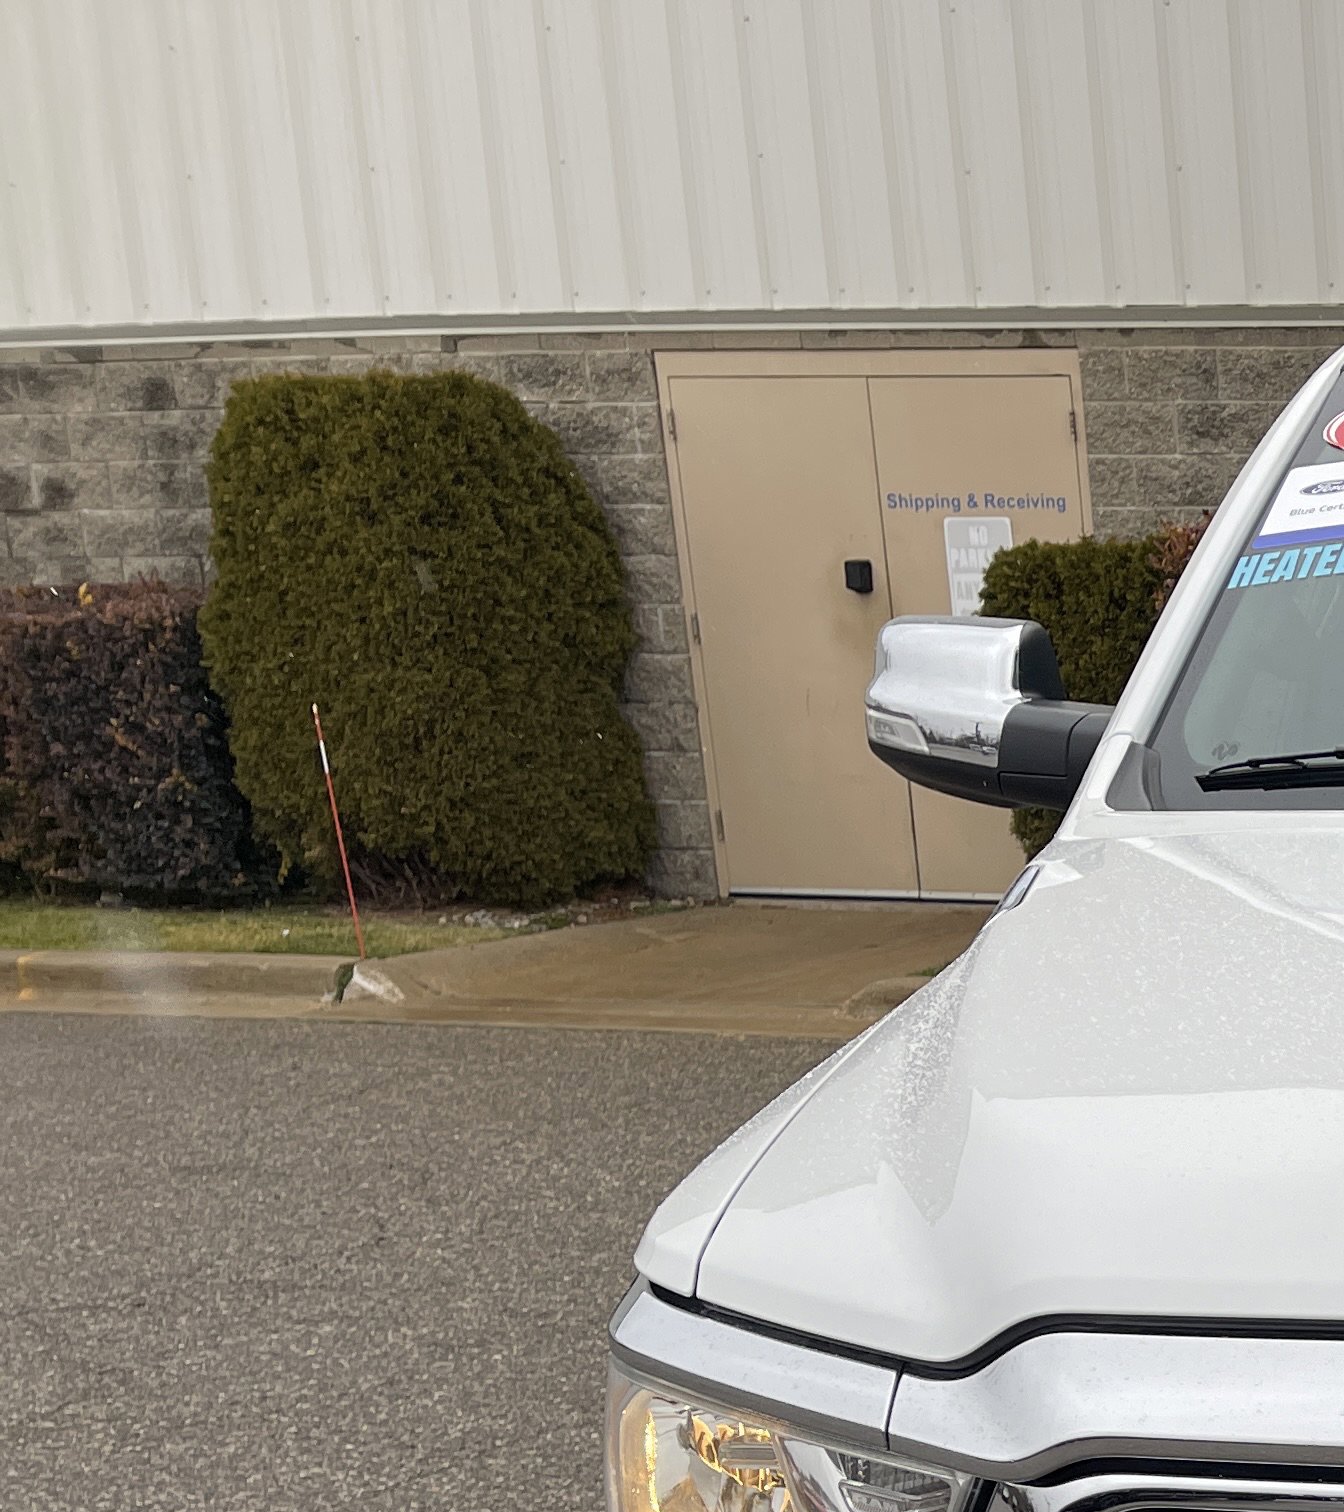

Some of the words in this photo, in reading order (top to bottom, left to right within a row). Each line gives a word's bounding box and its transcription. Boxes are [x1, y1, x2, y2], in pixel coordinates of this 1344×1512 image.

[886, 493, 961, 512] Shipping
[967, 493, 978, 509] &
[984, 493, 1066, 512] Receiving
[1289, 508, 1316, 517] Blue
[968, 526, 988, 546] NO
